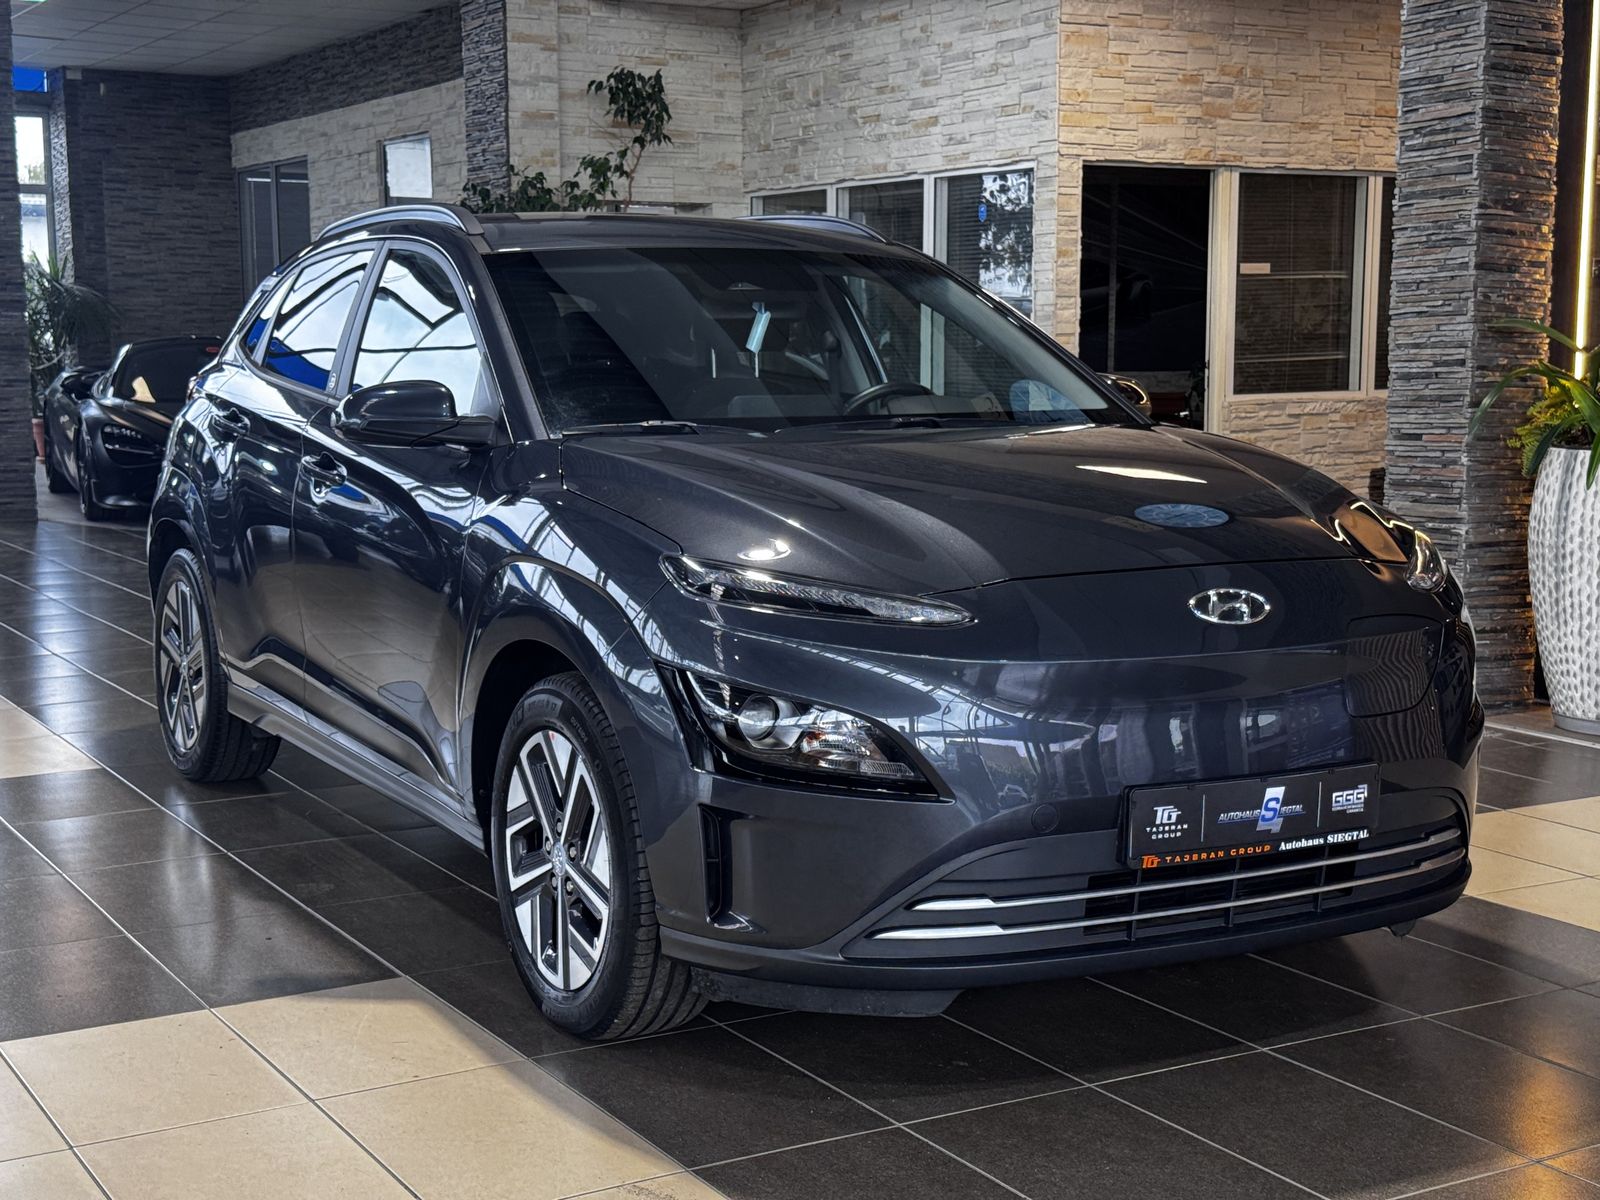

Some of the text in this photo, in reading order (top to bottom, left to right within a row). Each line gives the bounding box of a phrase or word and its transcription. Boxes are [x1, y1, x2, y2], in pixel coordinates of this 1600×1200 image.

[1217, 809, 1261, 822] AUTOHAUS
[1145, 823, 1188, 833] TAJERAN
[1151, 831, 1182, 840] GROUP
[1278, 829, 1370, 852] Autohaus SIEGTAL
[1165, 850, 1224, 864] TAJERAN
[1230, 844, 1272, 856] GROUP
